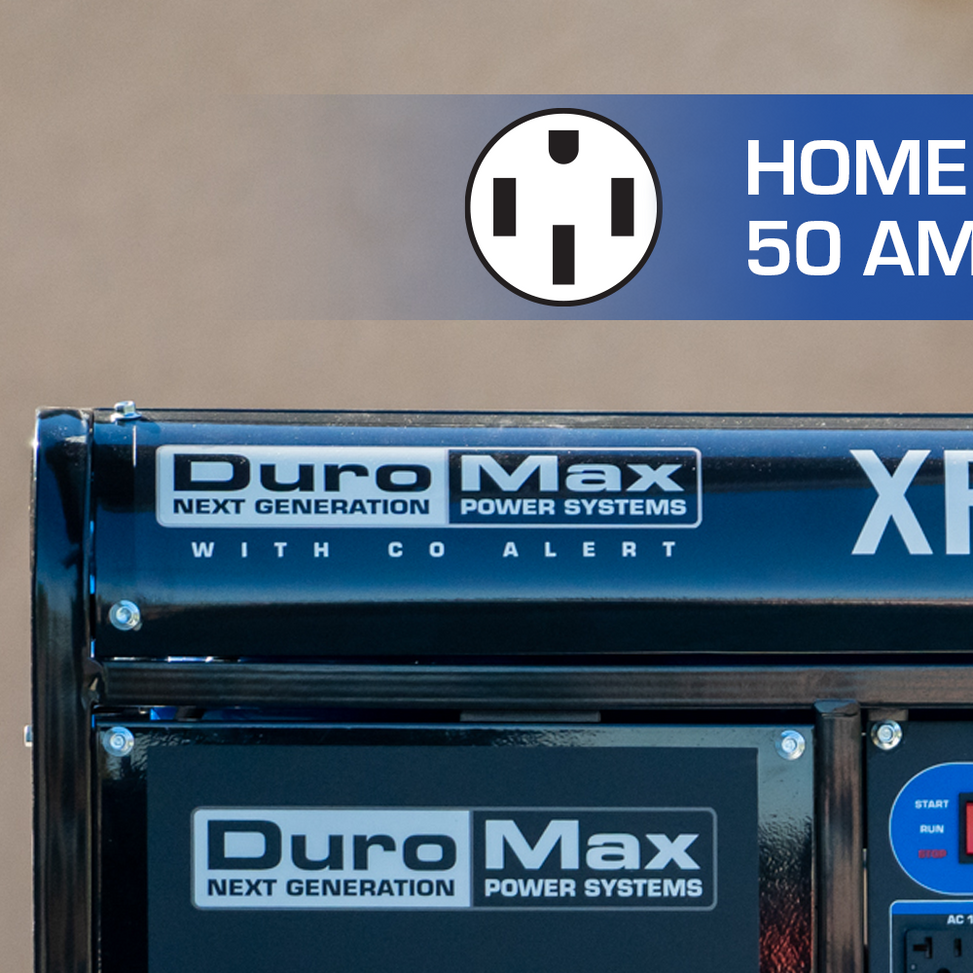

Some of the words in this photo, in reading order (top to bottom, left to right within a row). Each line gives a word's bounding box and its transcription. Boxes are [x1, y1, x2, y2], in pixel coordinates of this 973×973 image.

[173, 453, 432, 492] Duro
[461, 455, 684, 492] Max
[174, 499, 245, 514] NEXT
[255, 499, 429, 514] GENERATION
[461, 499, 554, 514] POWER
[564, 499, 686, 515] SYSTEMS
[192, 542, 328, 557] WITH
[388, 542, 444, 557] CO
[503, 542, 675, 557] ALERT
[208, 820, 456, 871] Duro
[486, 820, 700, 870] Max
[208, 879, 277, 896] NEXT
[286, 879, 454, 896] GENERATION
[485, 879, 575, 896] POWER
[585, 879, 702, 896] SYSTEMS
[948, 915, 964, 924] AC
